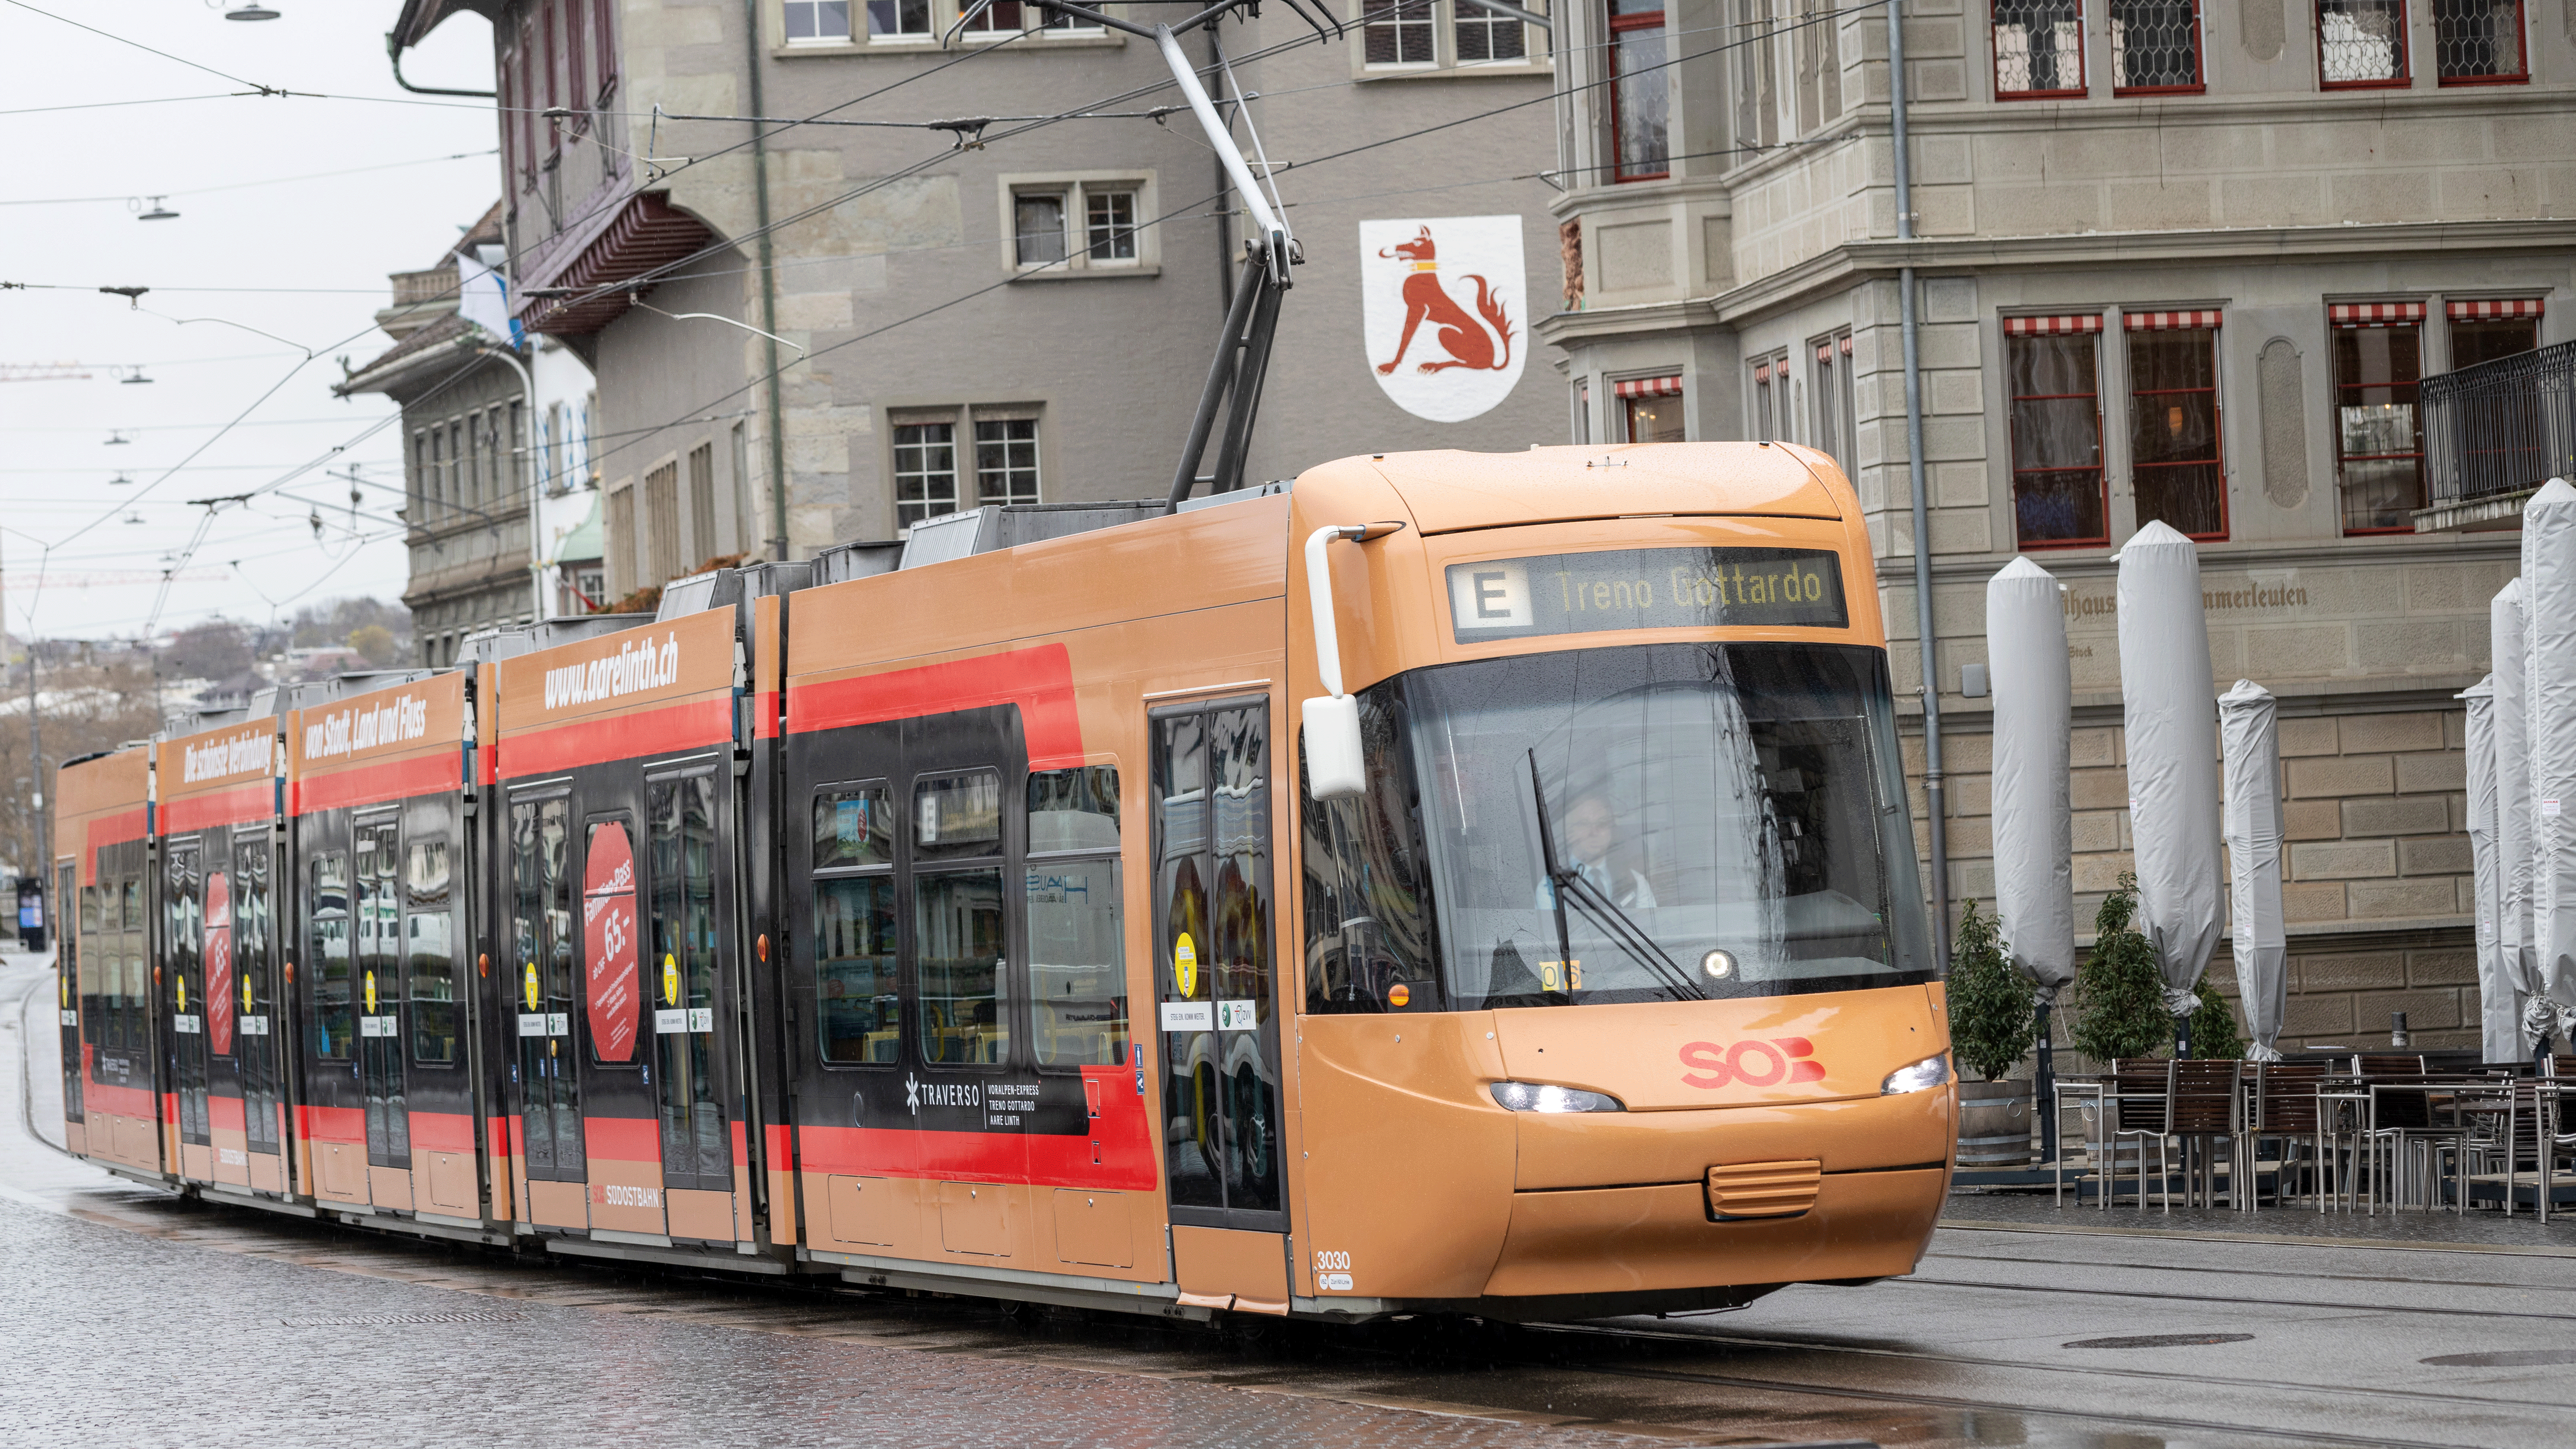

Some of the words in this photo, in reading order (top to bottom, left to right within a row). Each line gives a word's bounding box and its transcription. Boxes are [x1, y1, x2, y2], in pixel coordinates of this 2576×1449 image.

[1473, 572, 1511, 619] E
[1555, 570, 1653, 612] Treno
[1671, 562, 1822, 607] Gottardo
[545, 631, 678, 710] www.aarelinth.ch
[305, 723, 324, 760] von
[324, 709, 351, 758] Stadt,
[353, 702, 379, 750] Land
[379, 697, 400, 746] und
[399, 694, 427, 741] Fluss
[184, 743, 197, 783] Die
[229, 729, 273, 775] Verbindung
[1243, 1010, 1251, 1020] ZVV
[921, 1085, 979, 1106] TRAVERSO
[988, 1085, 1039, 1095] VORALPEN-EXPRESS
[989, 1100, 1006, 1110] TRENO
[1008, 1101, 1035, 1111] GOTTARDO
[990, 1115, 1004, 1125] AARE
[1005, 1116, 1020, 1126] LINTH
[1318, 1251, 1350, 1270] 3030
